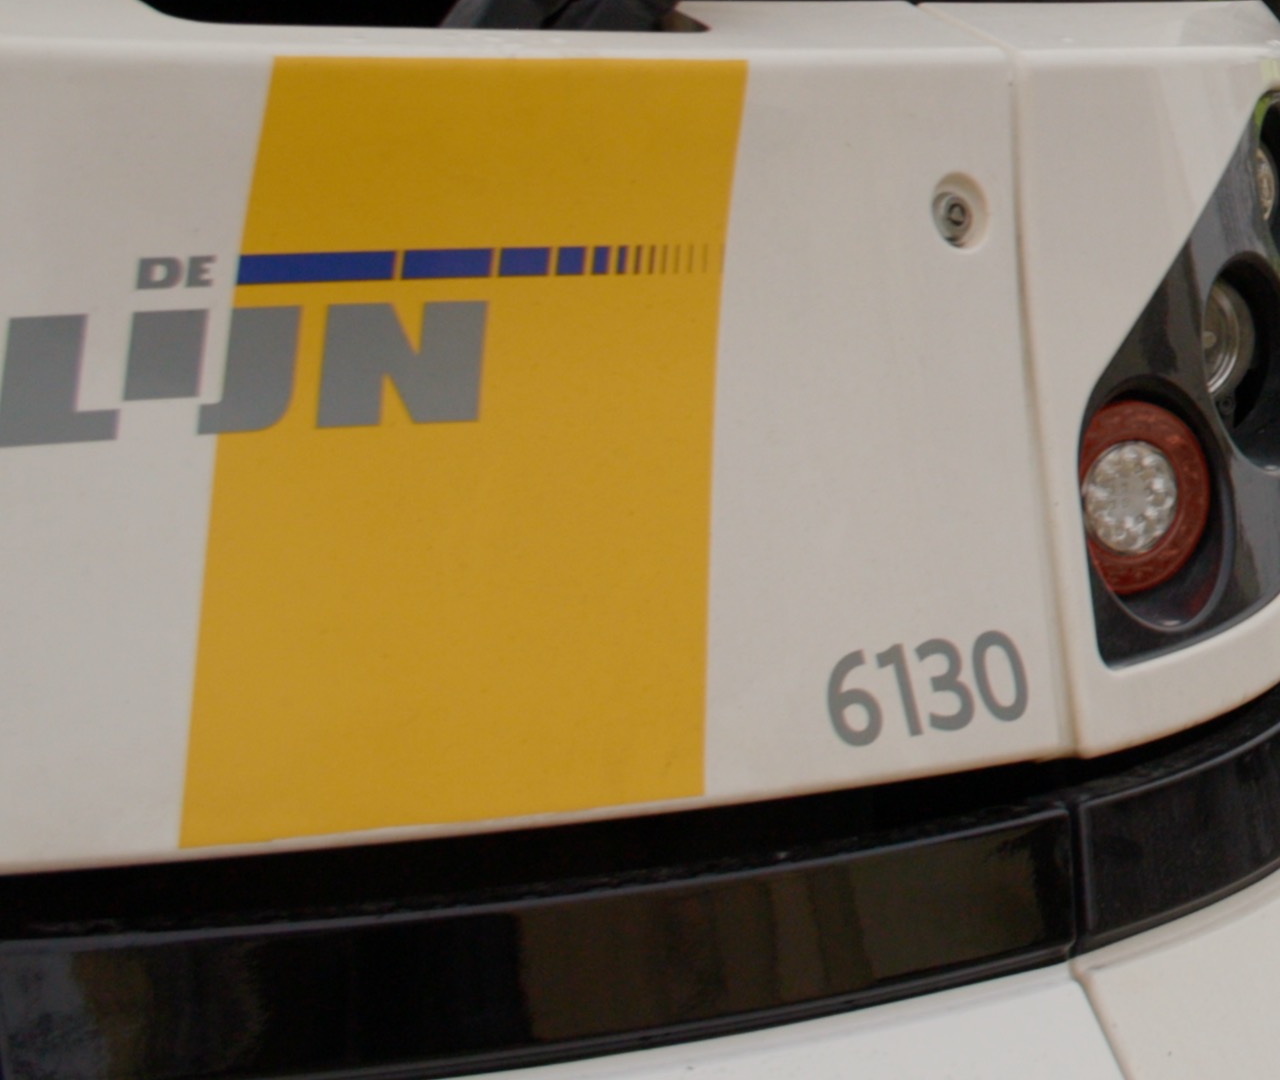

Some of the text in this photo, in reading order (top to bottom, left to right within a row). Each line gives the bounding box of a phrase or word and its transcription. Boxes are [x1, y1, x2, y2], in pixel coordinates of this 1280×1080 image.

[135, 255, 217, 290] DE
[0, 300, 489, 449] LIJN
[827, 630, 1029, 747] 6130
